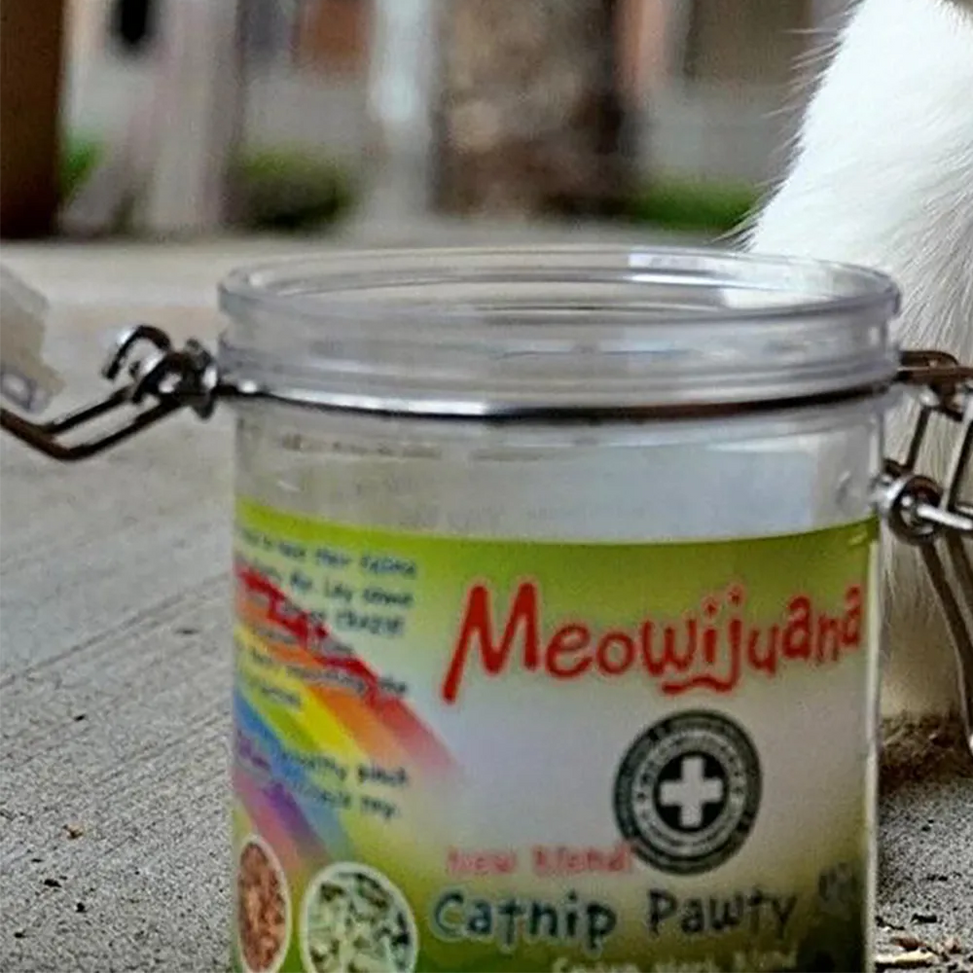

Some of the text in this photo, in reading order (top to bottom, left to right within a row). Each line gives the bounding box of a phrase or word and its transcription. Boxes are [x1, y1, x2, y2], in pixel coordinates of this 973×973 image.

[441, 581, 864, 704] Meowijuana
[433, 888, 798, 952] Catnip Pawty
